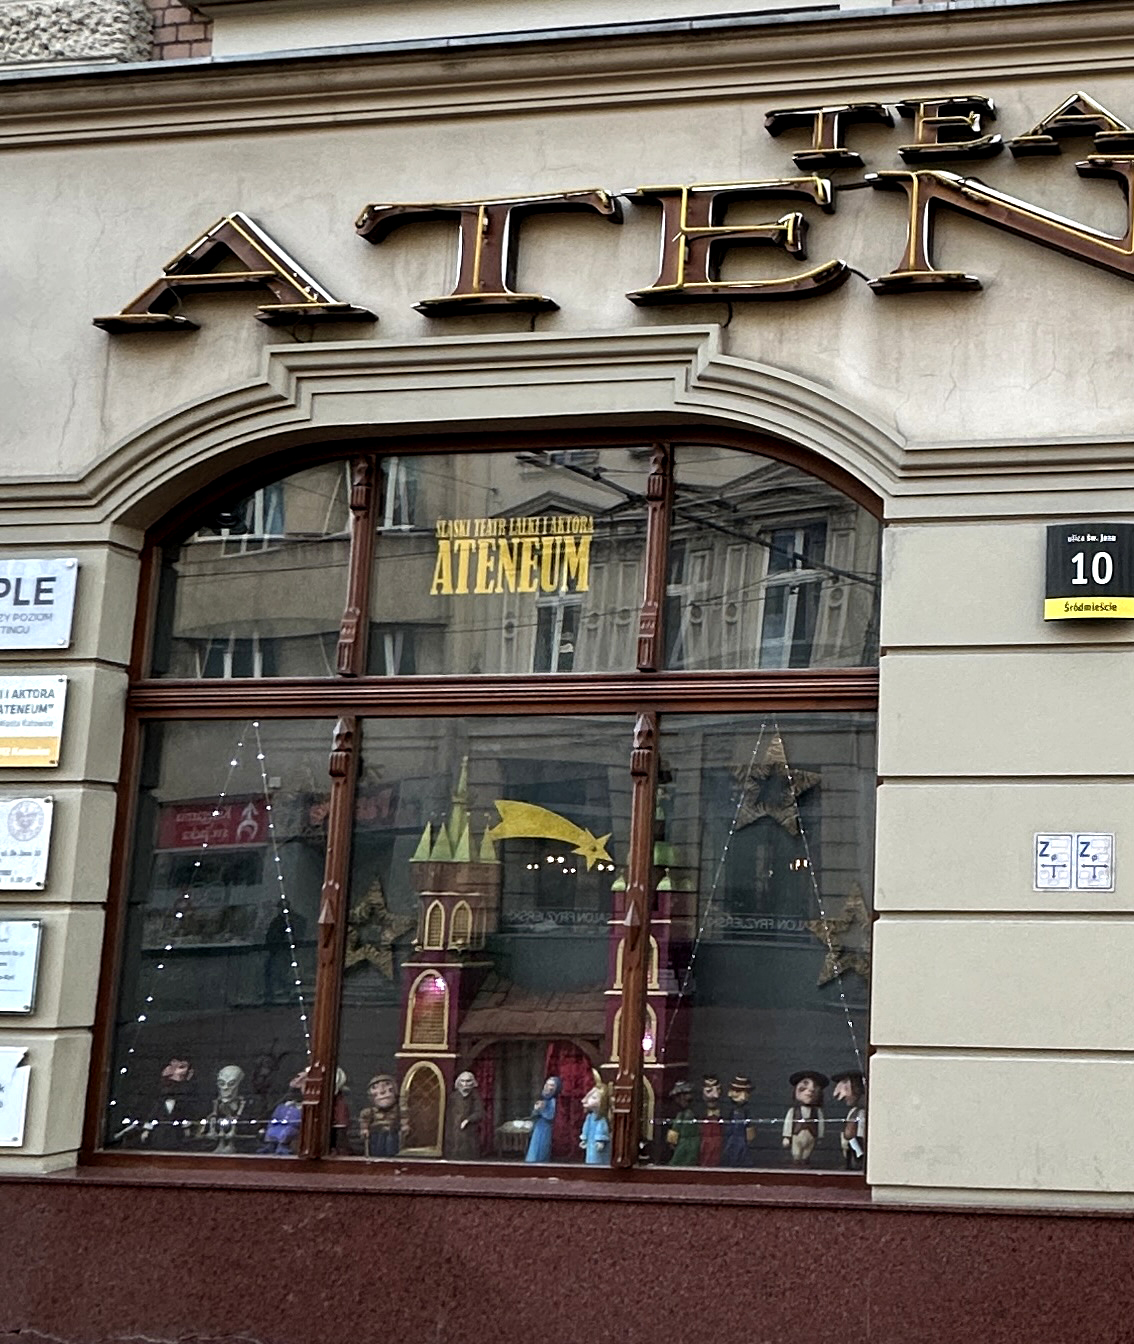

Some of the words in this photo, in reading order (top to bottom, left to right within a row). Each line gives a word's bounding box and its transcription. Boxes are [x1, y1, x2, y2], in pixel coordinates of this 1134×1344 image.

[474, 519, 505, 536] TEATR
[510, 518, 541, 535] LALKI
[551, 516, 594, 534] AKTORA
[1067, 534, 1085, 542] ulica
[1100, 534, 1116, 542] Jana
[430, 536, 592, 595] ATENEUM
[1071, 552, 1113, 585] 10
[1064, 601, 1118, 612] Śródmieście
[11, 689, 55, 698] AKTORA
[1039, 841, 1050, 857] Z
[1079, 841, 1090, 858] Z
